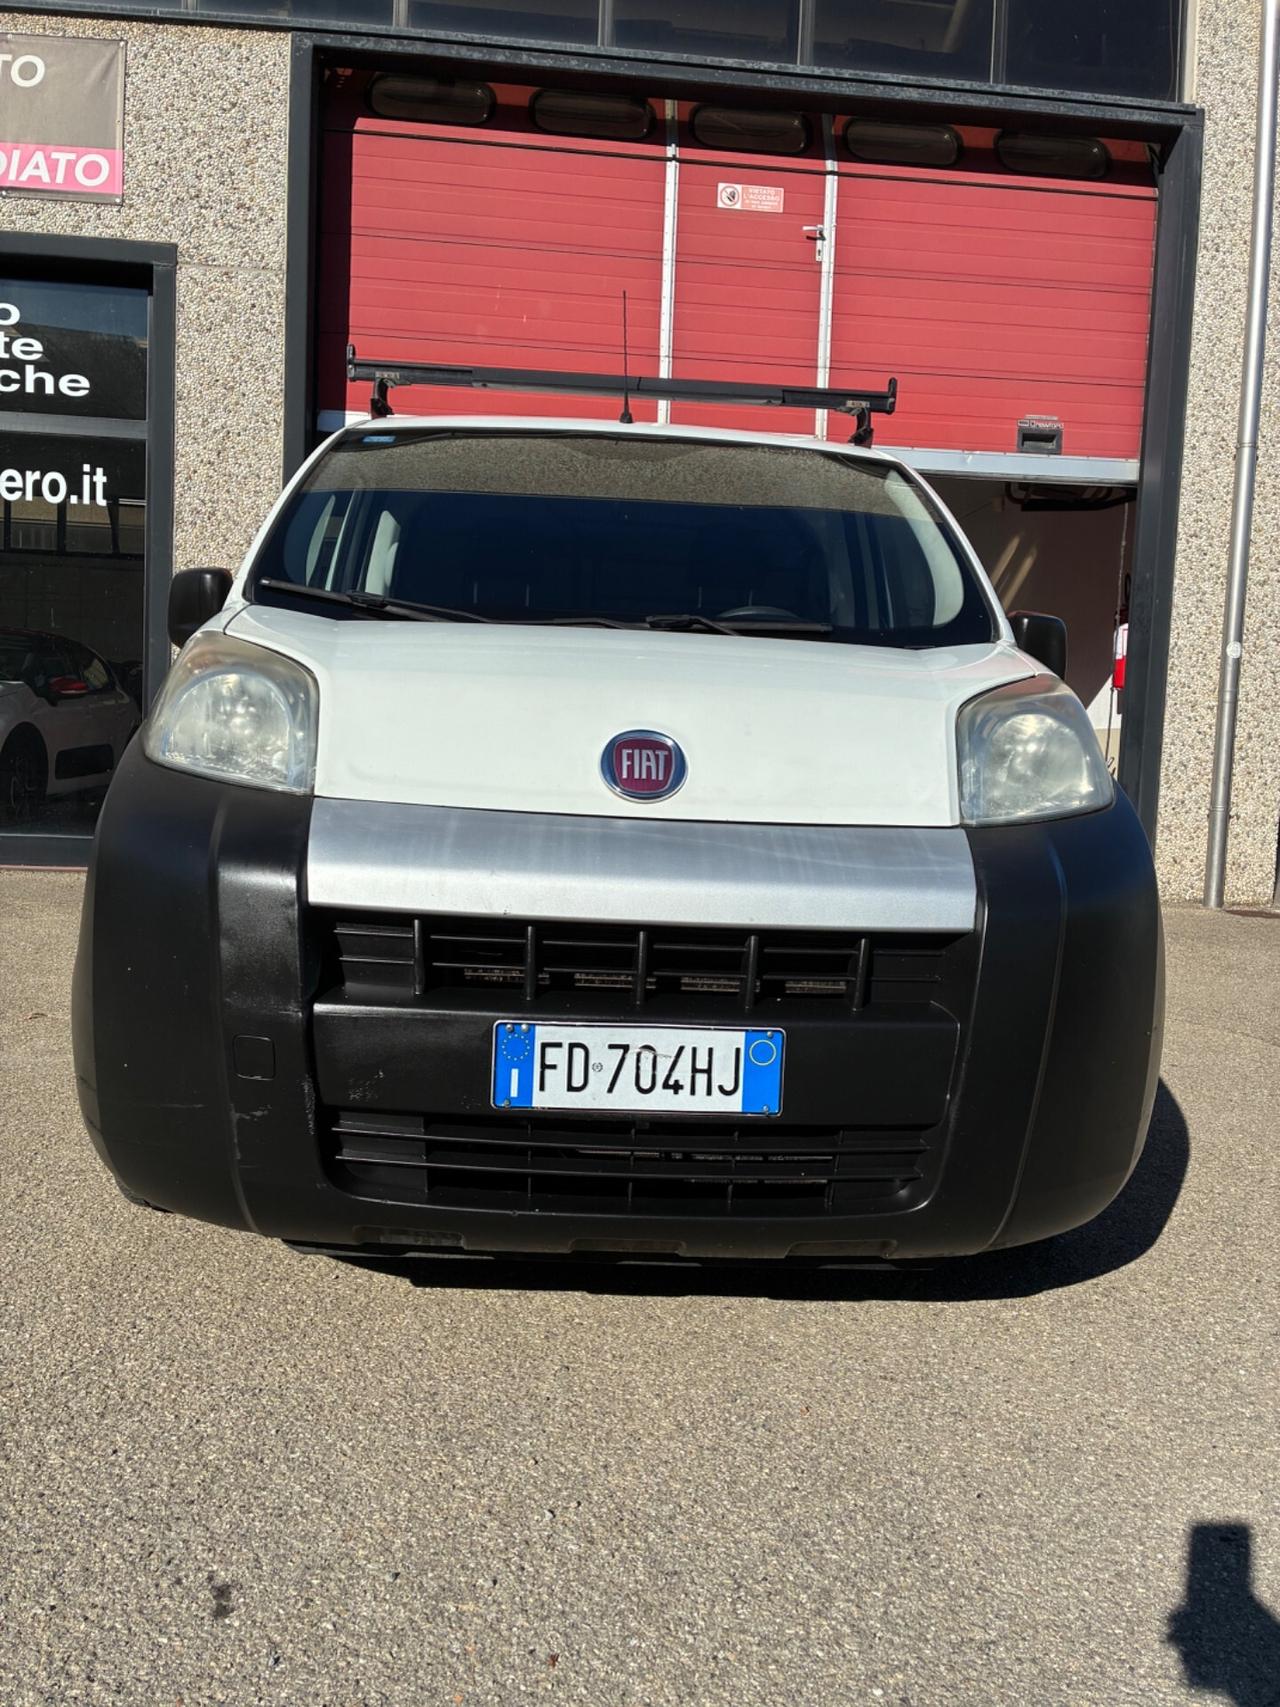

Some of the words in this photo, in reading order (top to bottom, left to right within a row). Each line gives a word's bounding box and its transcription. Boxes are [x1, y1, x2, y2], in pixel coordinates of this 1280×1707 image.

[0, 149, 110, 187] IATO
[0, 364, 91, 397] che
[0, 463, 108, 507] ero.it
[621, 748, 669, 781] FIAT
[538, 1041, 590, 1093] FD
[606, 1043, 742, 1097] 704HJ
